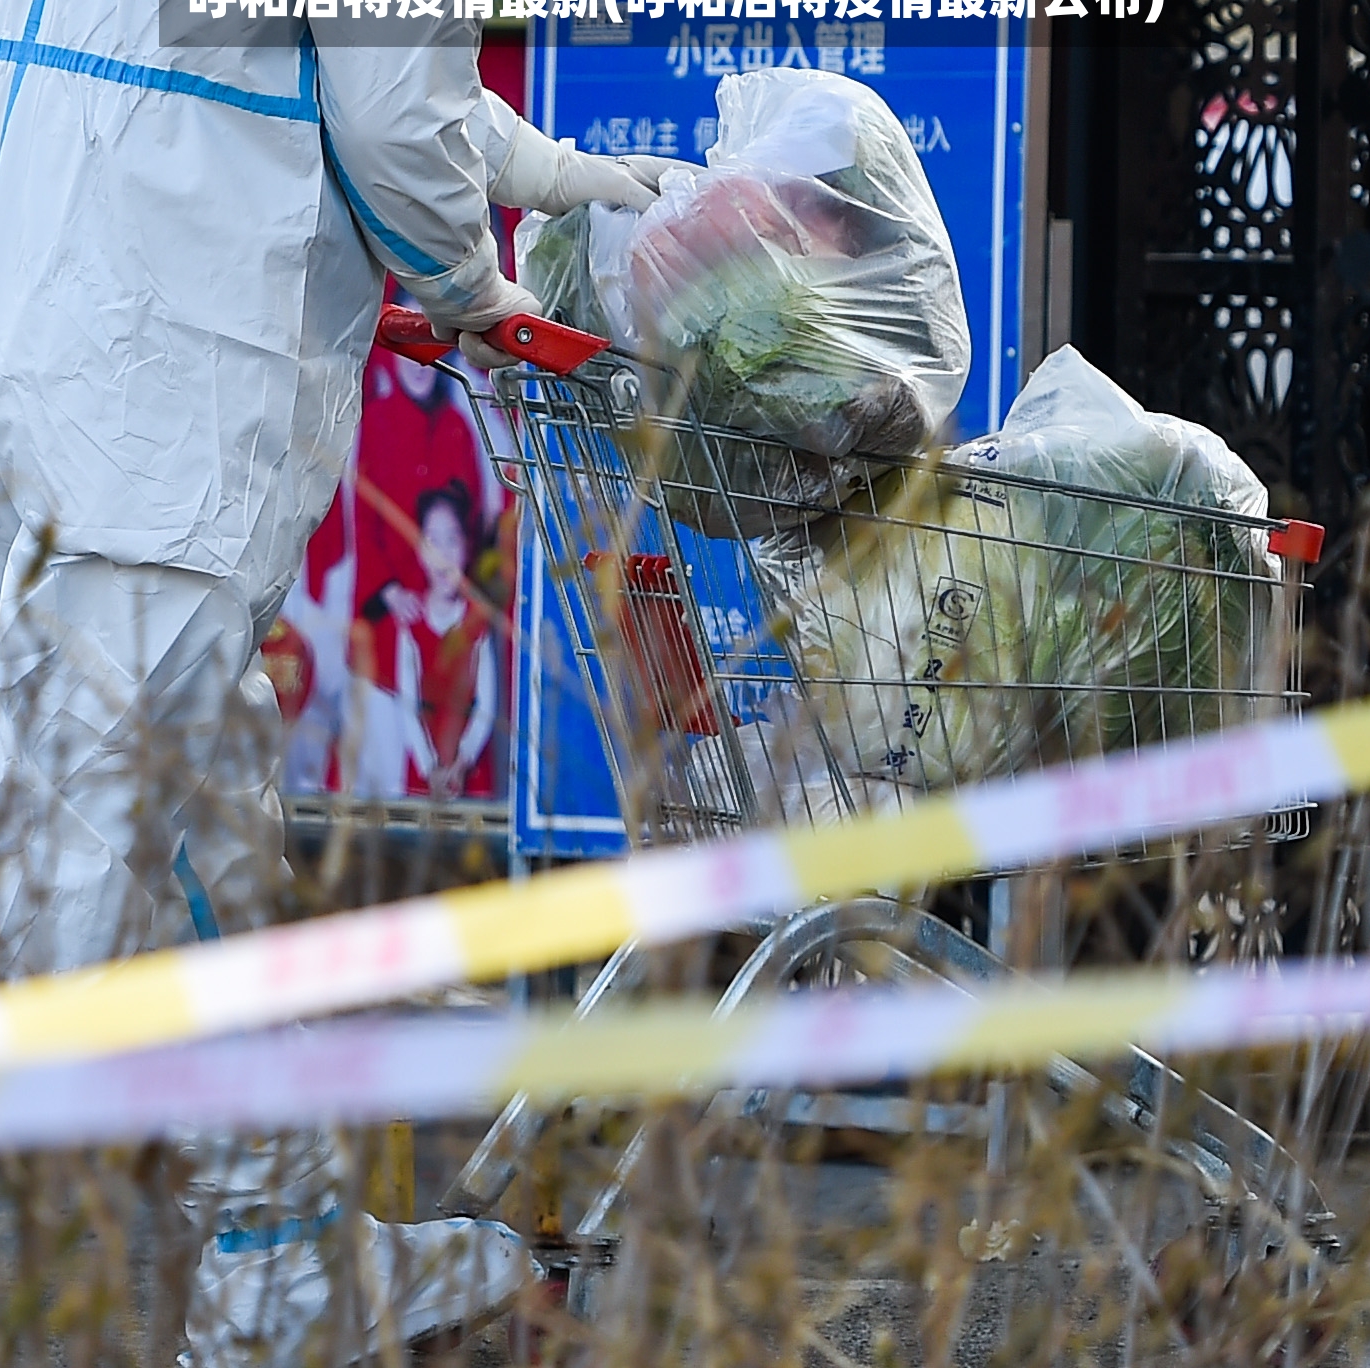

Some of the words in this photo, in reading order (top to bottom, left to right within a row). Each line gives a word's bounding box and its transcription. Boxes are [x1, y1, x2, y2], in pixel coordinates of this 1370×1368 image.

[666, 20, 886, 78] 小区出入管理
[584, 116, 679, 154] 小区业主
